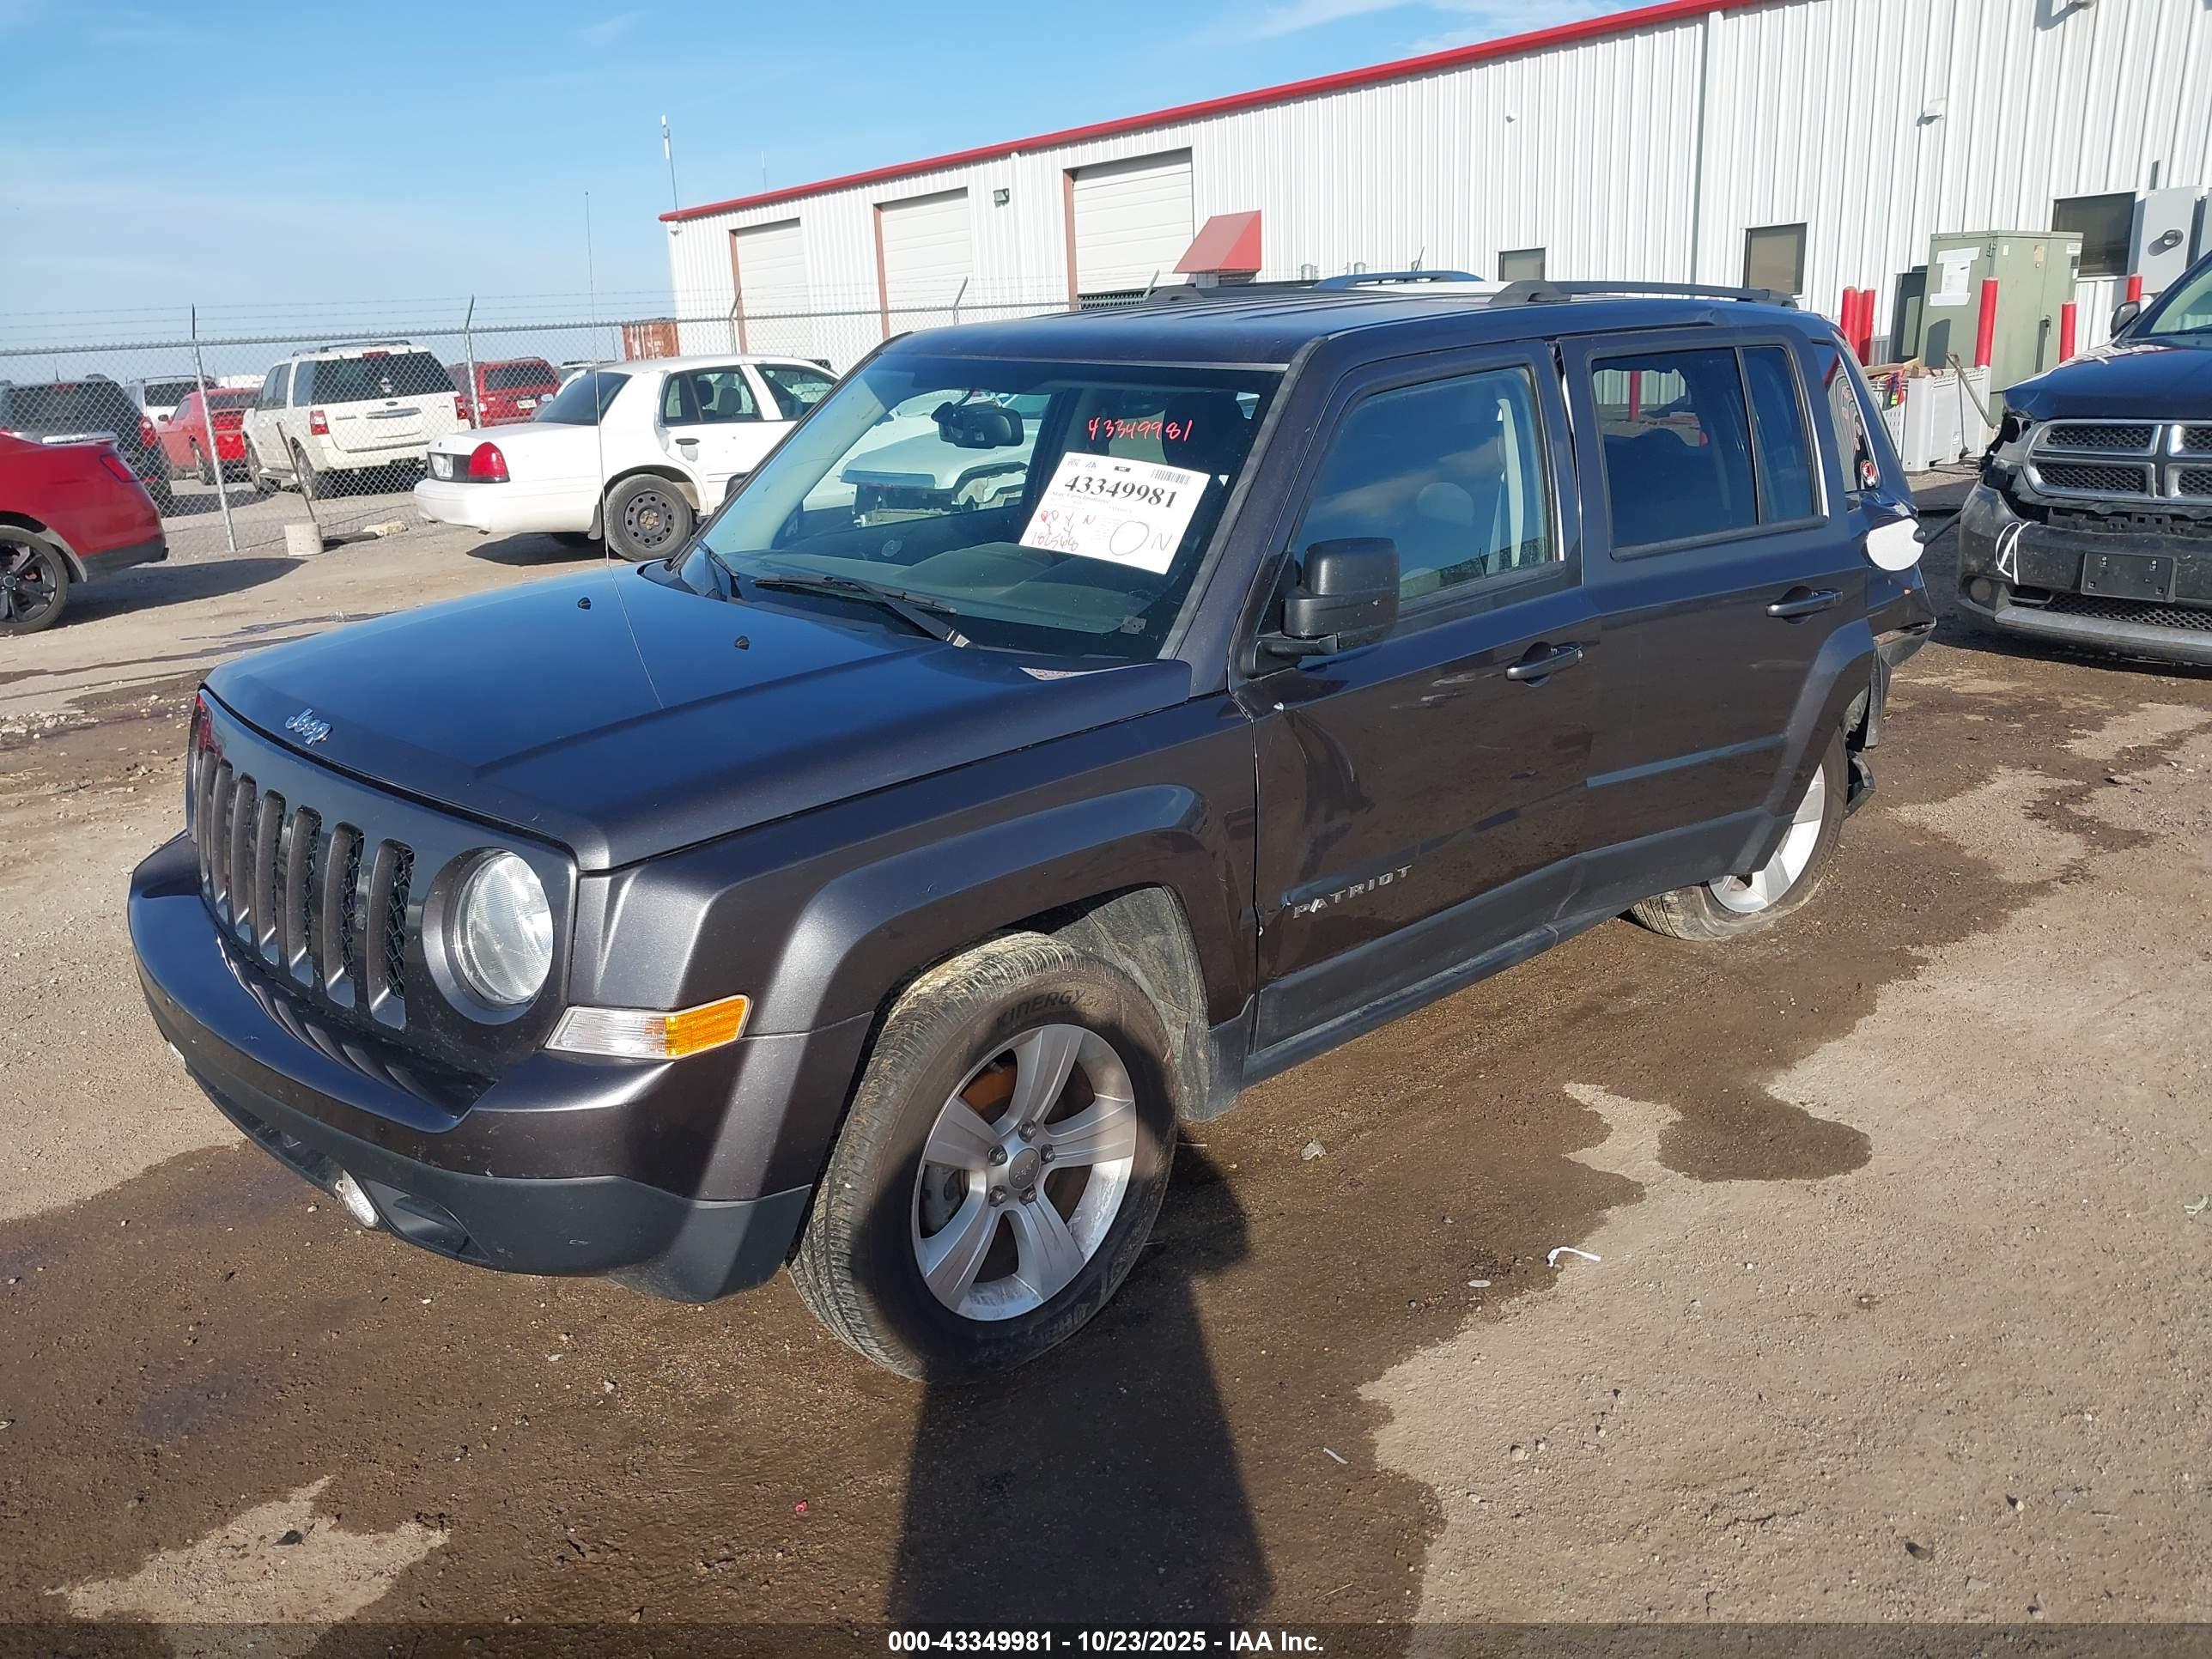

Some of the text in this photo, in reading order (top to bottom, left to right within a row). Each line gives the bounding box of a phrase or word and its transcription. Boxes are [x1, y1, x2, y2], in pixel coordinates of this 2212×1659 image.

[1088, 417, 1193, 441] 43349981
[1065, 474, 1178, 508] 43349981
[285, 708, 331, 745] Jeep
[1292, 865, 1413, 920] PATRIOT
[996, 989, 1086, 1030] KINERGY
